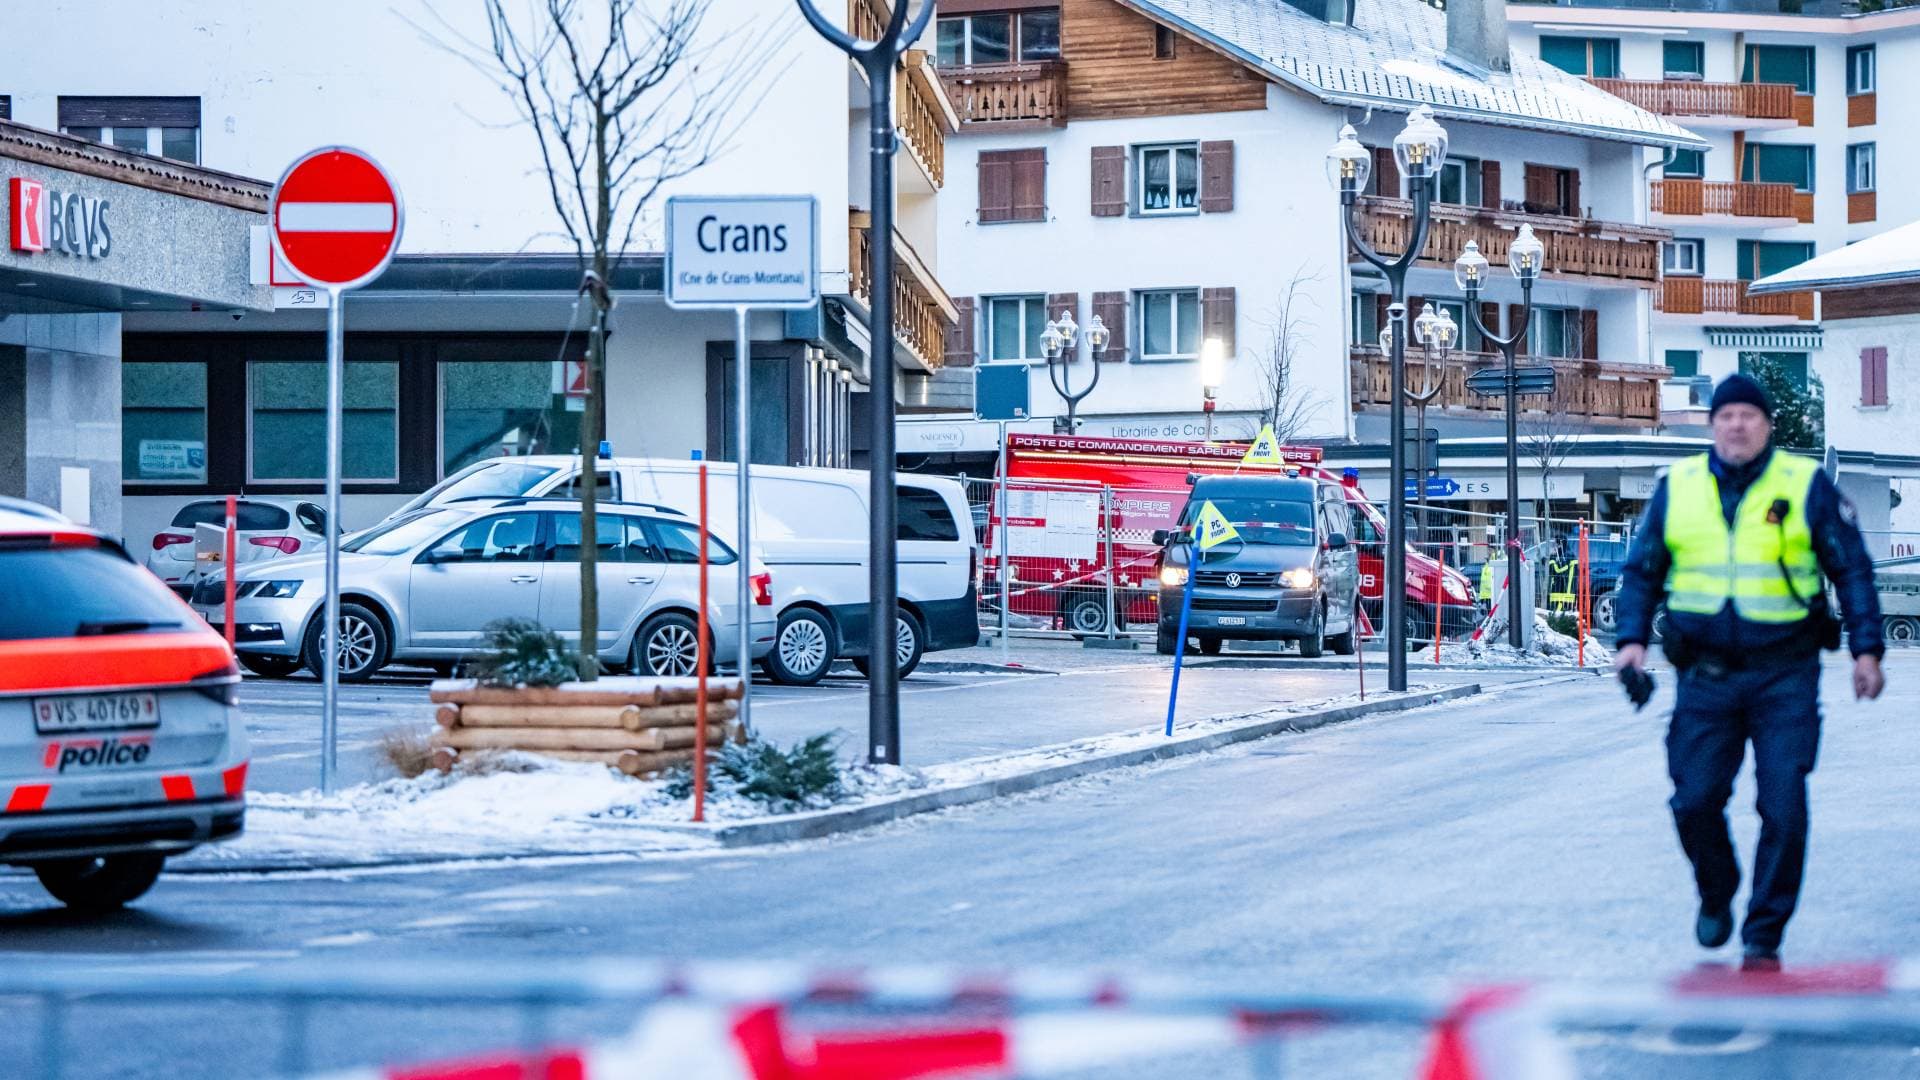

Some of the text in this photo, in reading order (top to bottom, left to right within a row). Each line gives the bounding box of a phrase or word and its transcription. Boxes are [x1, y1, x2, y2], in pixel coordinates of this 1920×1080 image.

[50, 190, 111, 258] BCVS
[697, 215, 788, 253] Crans
[679, 270, 805, 286] (Cne de Crans-Montana)
[1112, 424, 1219, 438] Librairie de Cras
[1015, 437, 1057, 447] POSTE
[1059, 440, 1076, 448] DE
[1078, 440, 1186, 454] COMMANDEMENT
[1188, 446, 1245, 457] SAPEURS
[1258, 442, 1269, 450] PC
[1211, 520, 1221, 530] PC
[54, 697, 140, 723] VS 40769
[58, 739, 151, 774] police
